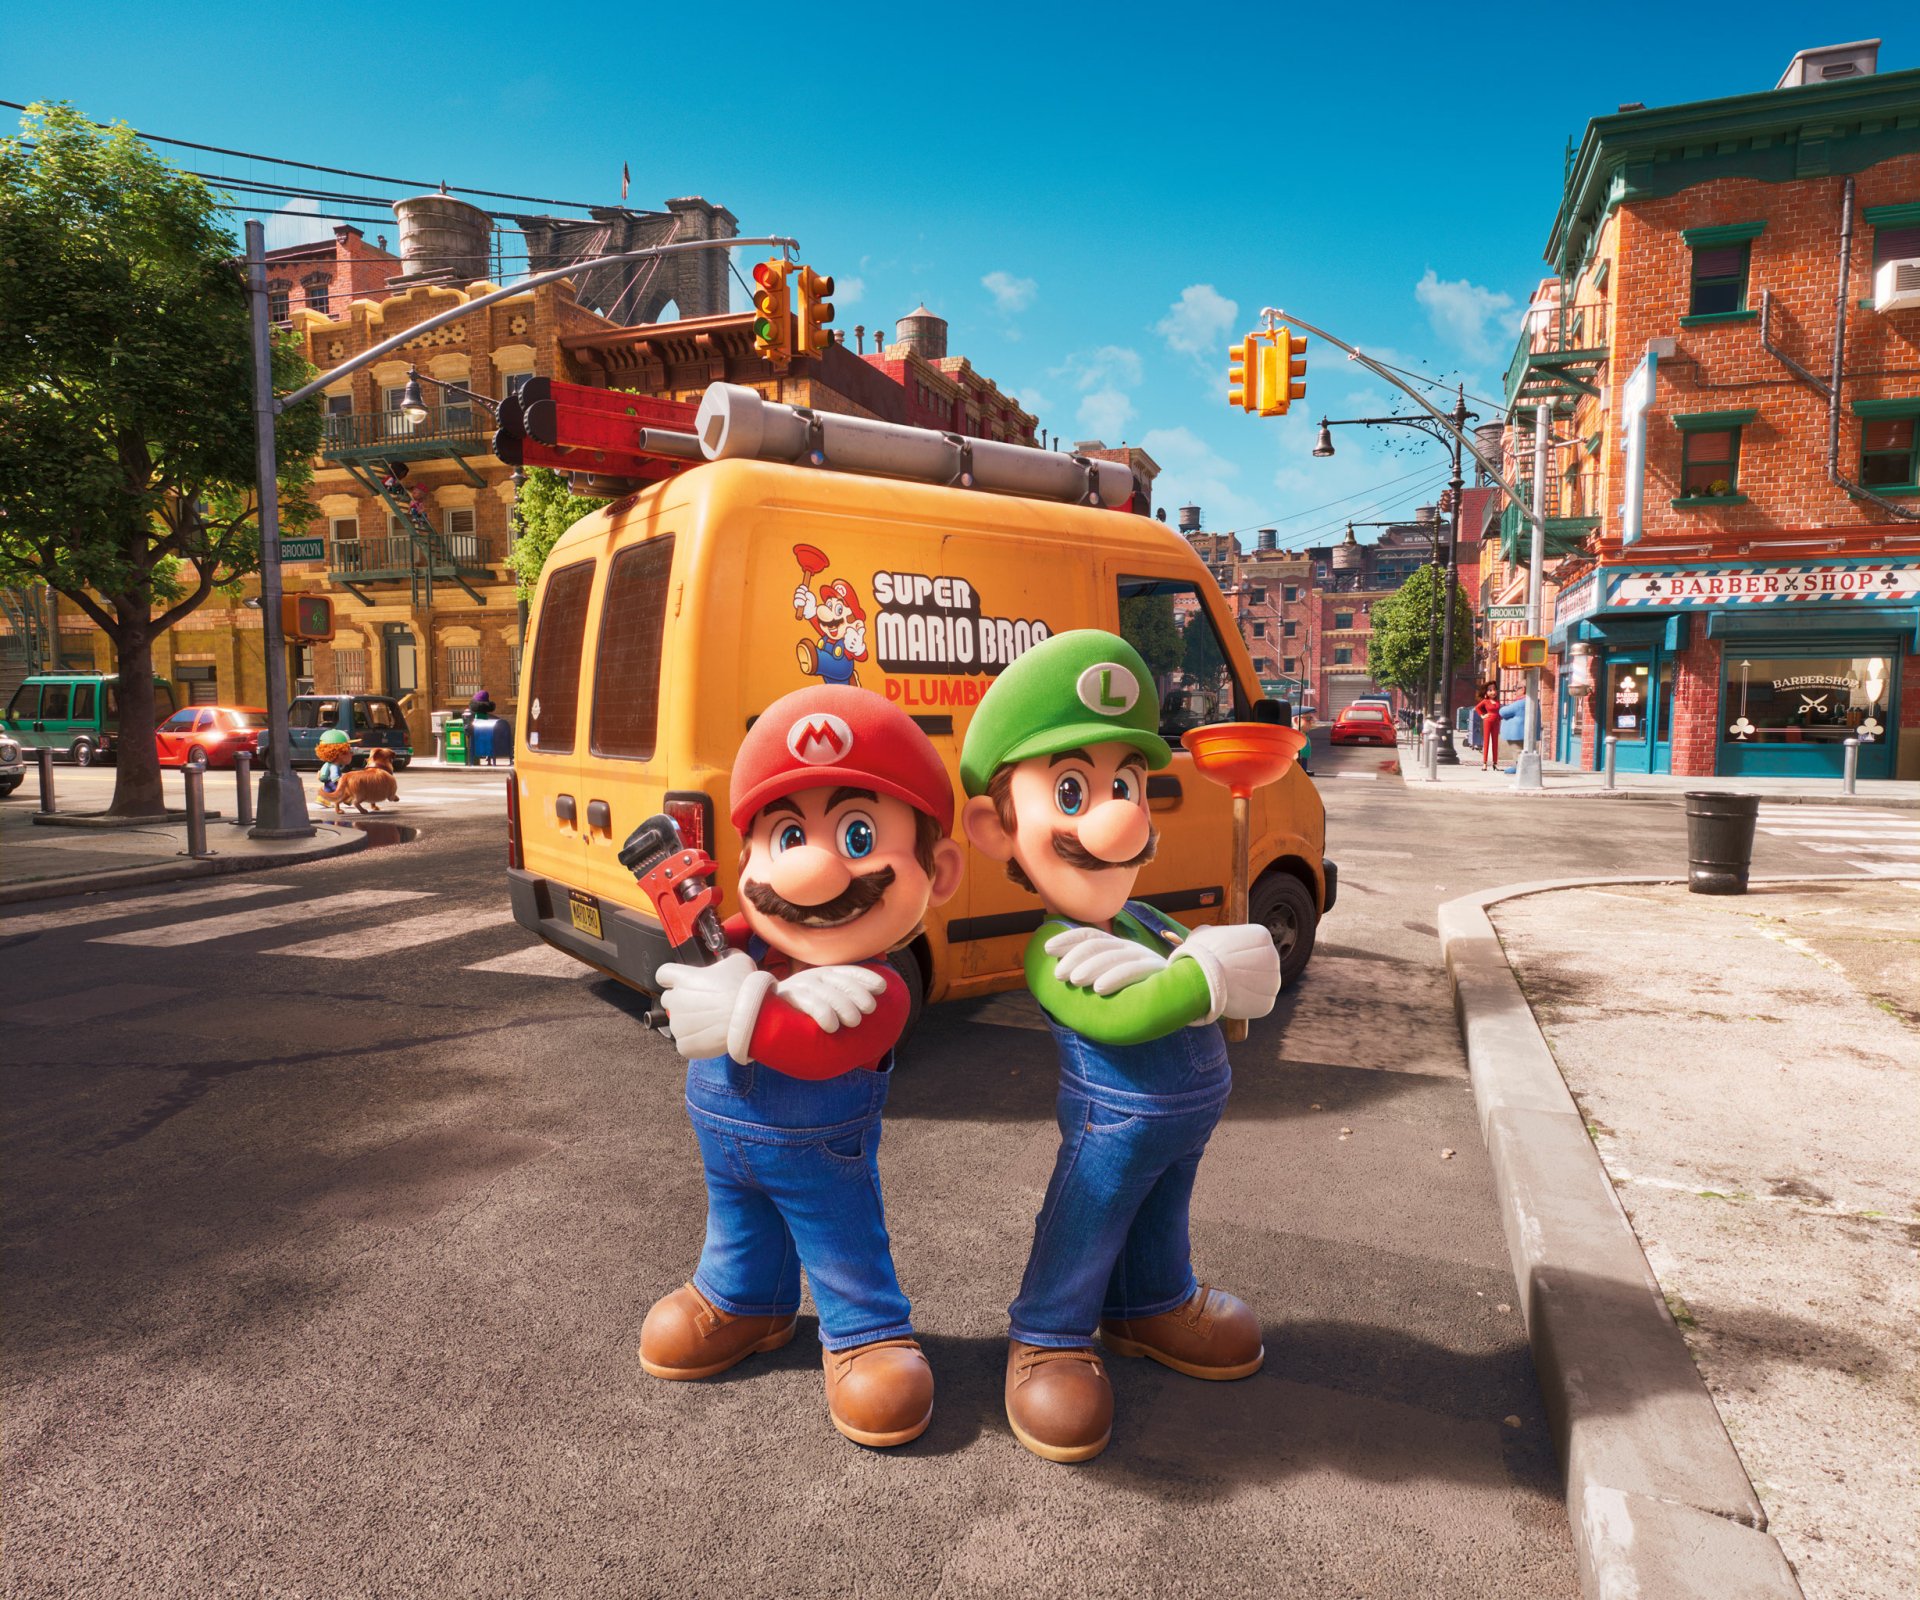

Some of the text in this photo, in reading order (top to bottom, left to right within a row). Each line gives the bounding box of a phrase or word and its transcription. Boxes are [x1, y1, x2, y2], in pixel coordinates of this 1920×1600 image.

[281, 543, 321, 557] BROOKLYN
[873, 572, 972, 609] SUPER
[1670, 573, 1873, 595] BARBER SHOP
[1490, 607, 1525, 618] BROOKLYN
[876, 612, 974, 664] MARIO
[885, 679, 993, 706] PLUMBI
[1101, 669, 1126, 707] L
[795, 720, 844, 757] M
